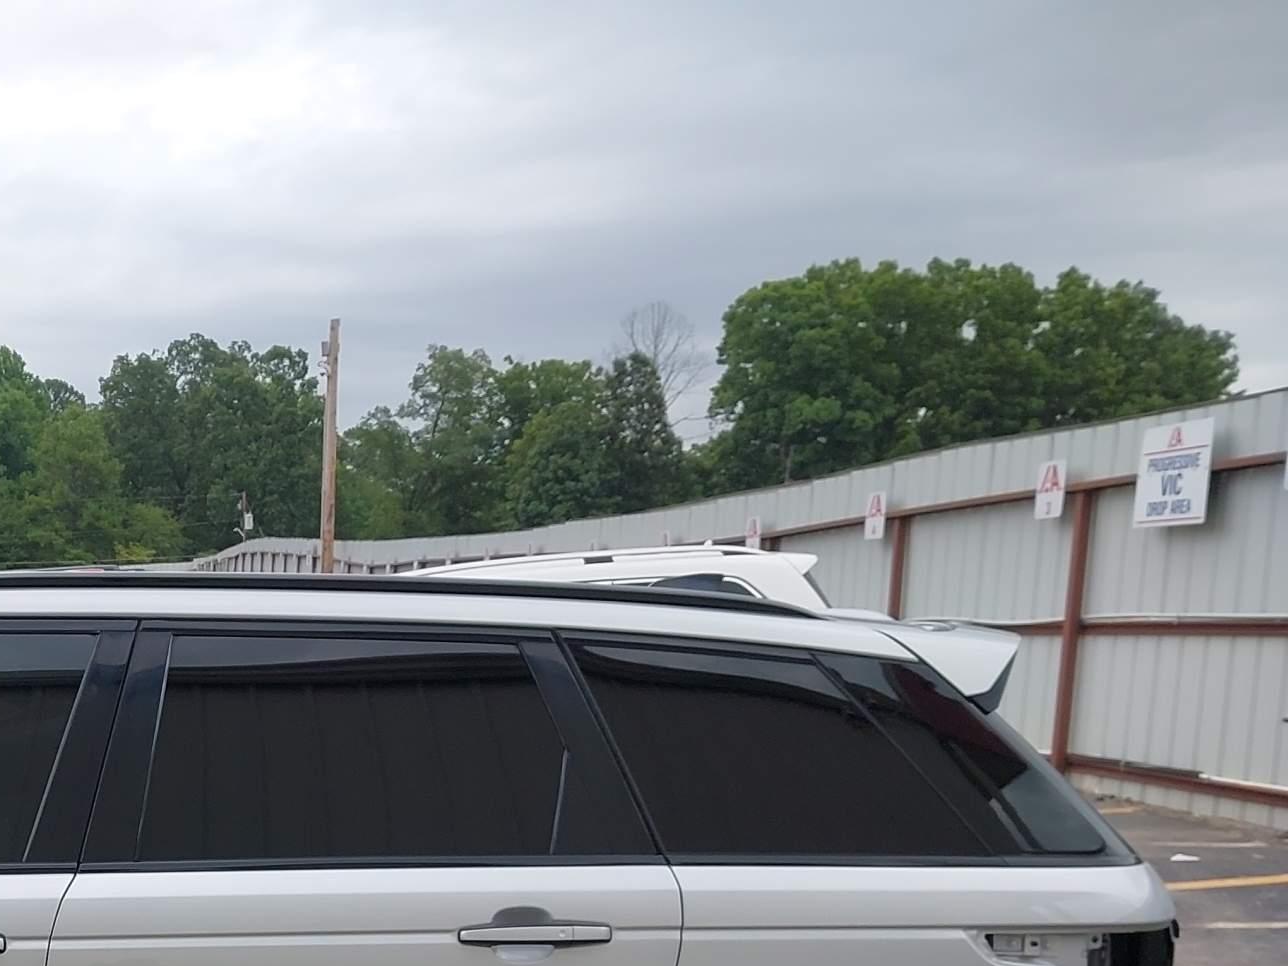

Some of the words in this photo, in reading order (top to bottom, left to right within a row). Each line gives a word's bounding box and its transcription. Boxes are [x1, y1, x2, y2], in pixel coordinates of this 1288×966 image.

[1147, 452, 1201, 472] PROGRESSIVE
[1161, 473, 1184, 496] VIC
[1146, 501, 1168, 517] DROP
[1170, 499, 1191, 514] AREA
